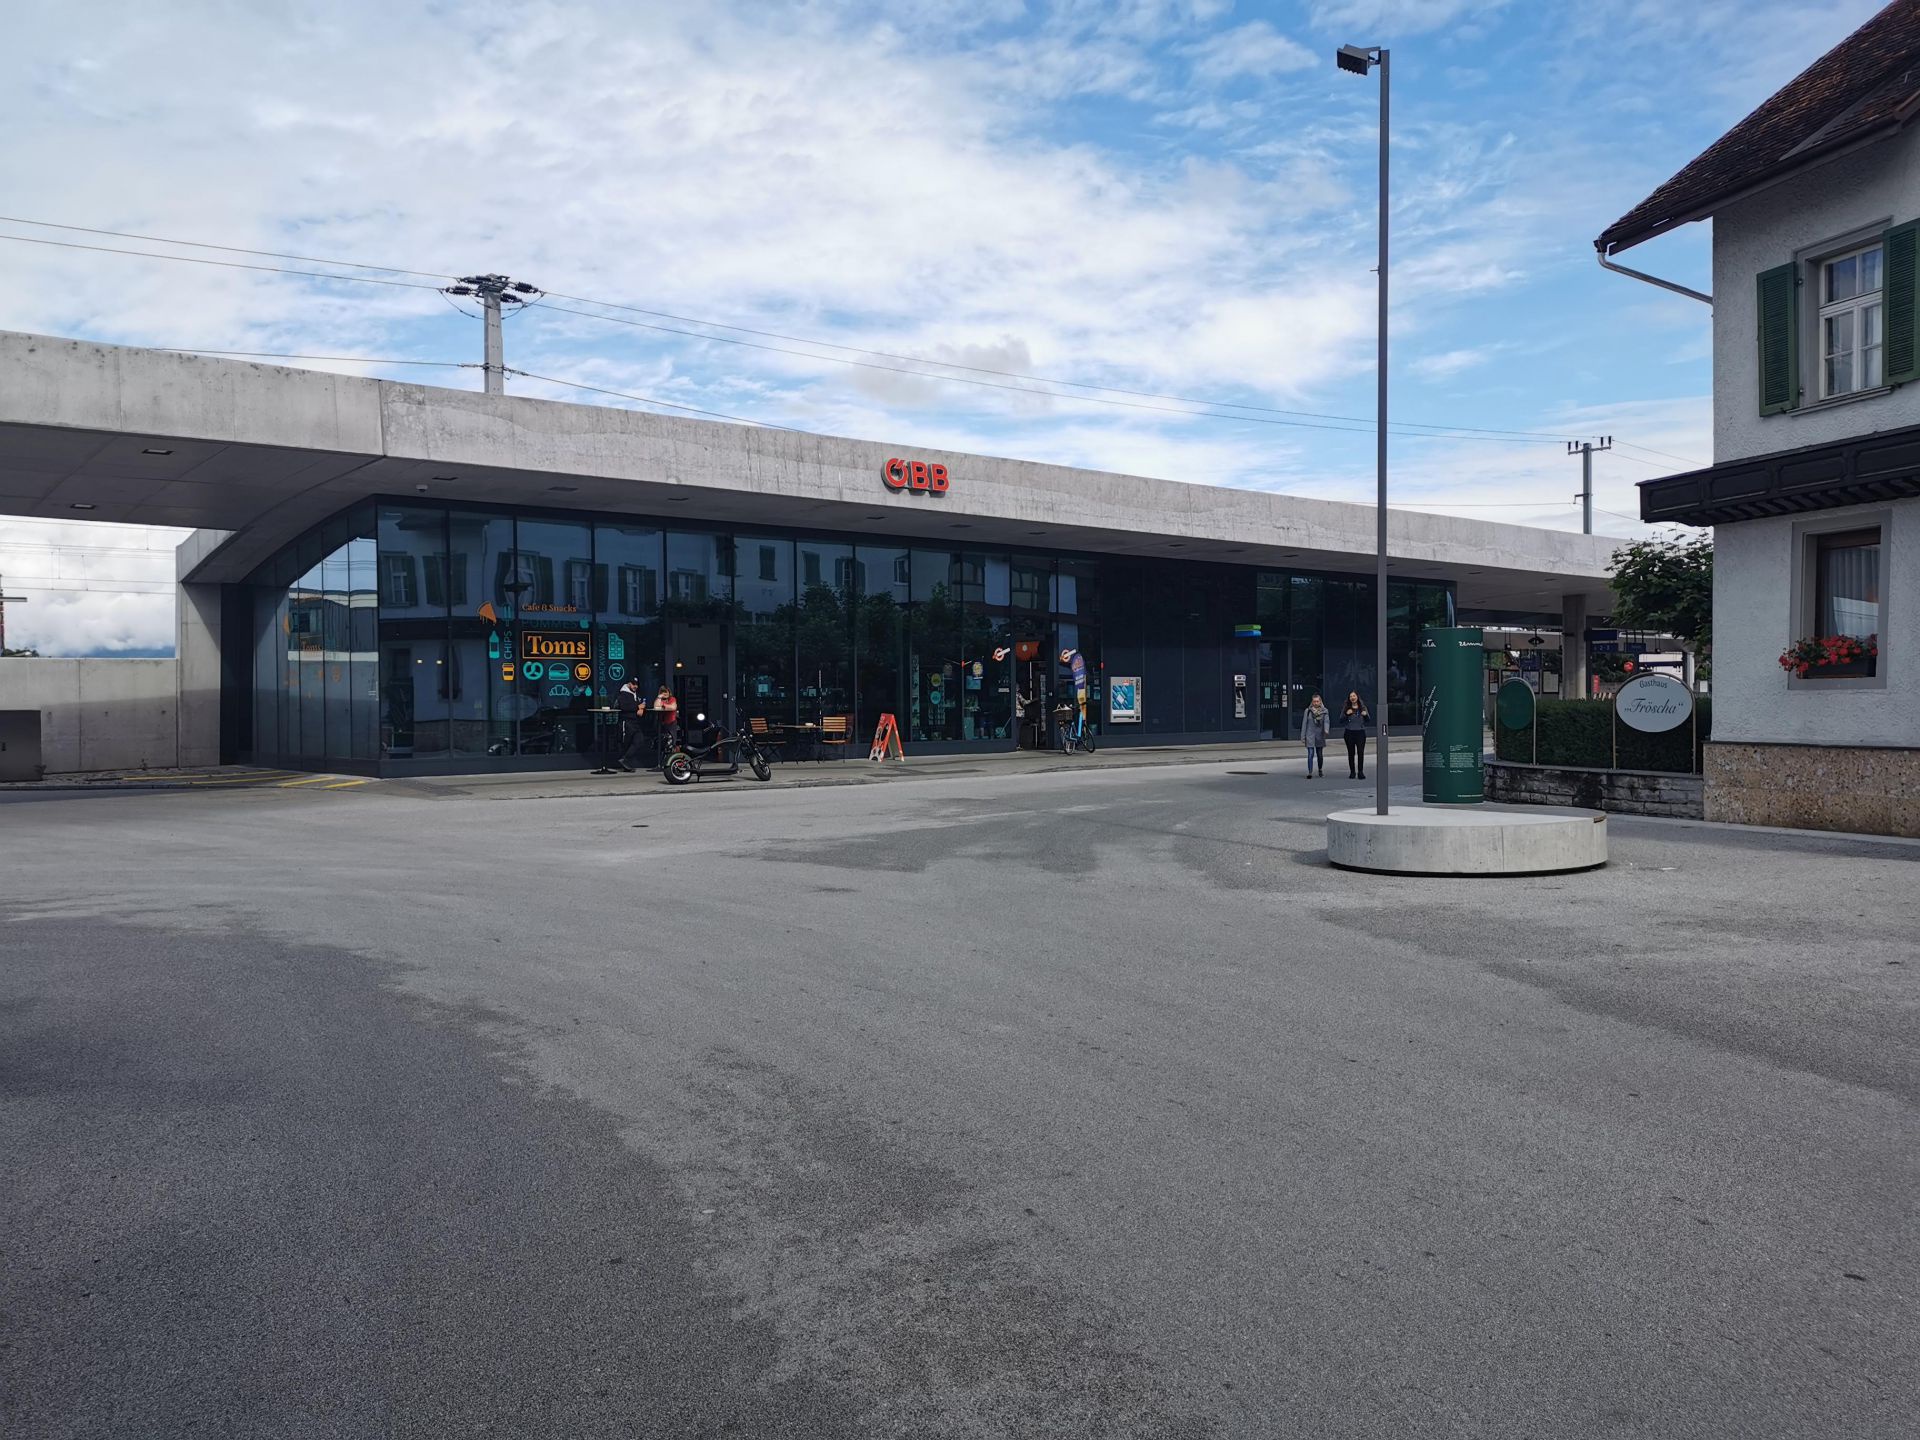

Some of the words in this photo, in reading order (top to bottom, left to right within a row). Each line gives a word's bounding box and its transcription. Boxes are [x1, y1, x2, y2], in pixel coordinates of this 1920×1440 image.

[884, 458, 950, 492] ÖBB
[549, 604, 577, 613] Snacks
[504, 630, 512, 660] CHIPS
[528, 635, 586, 655] Toms
[1640, 680, 1667, 688] Gasthaus
